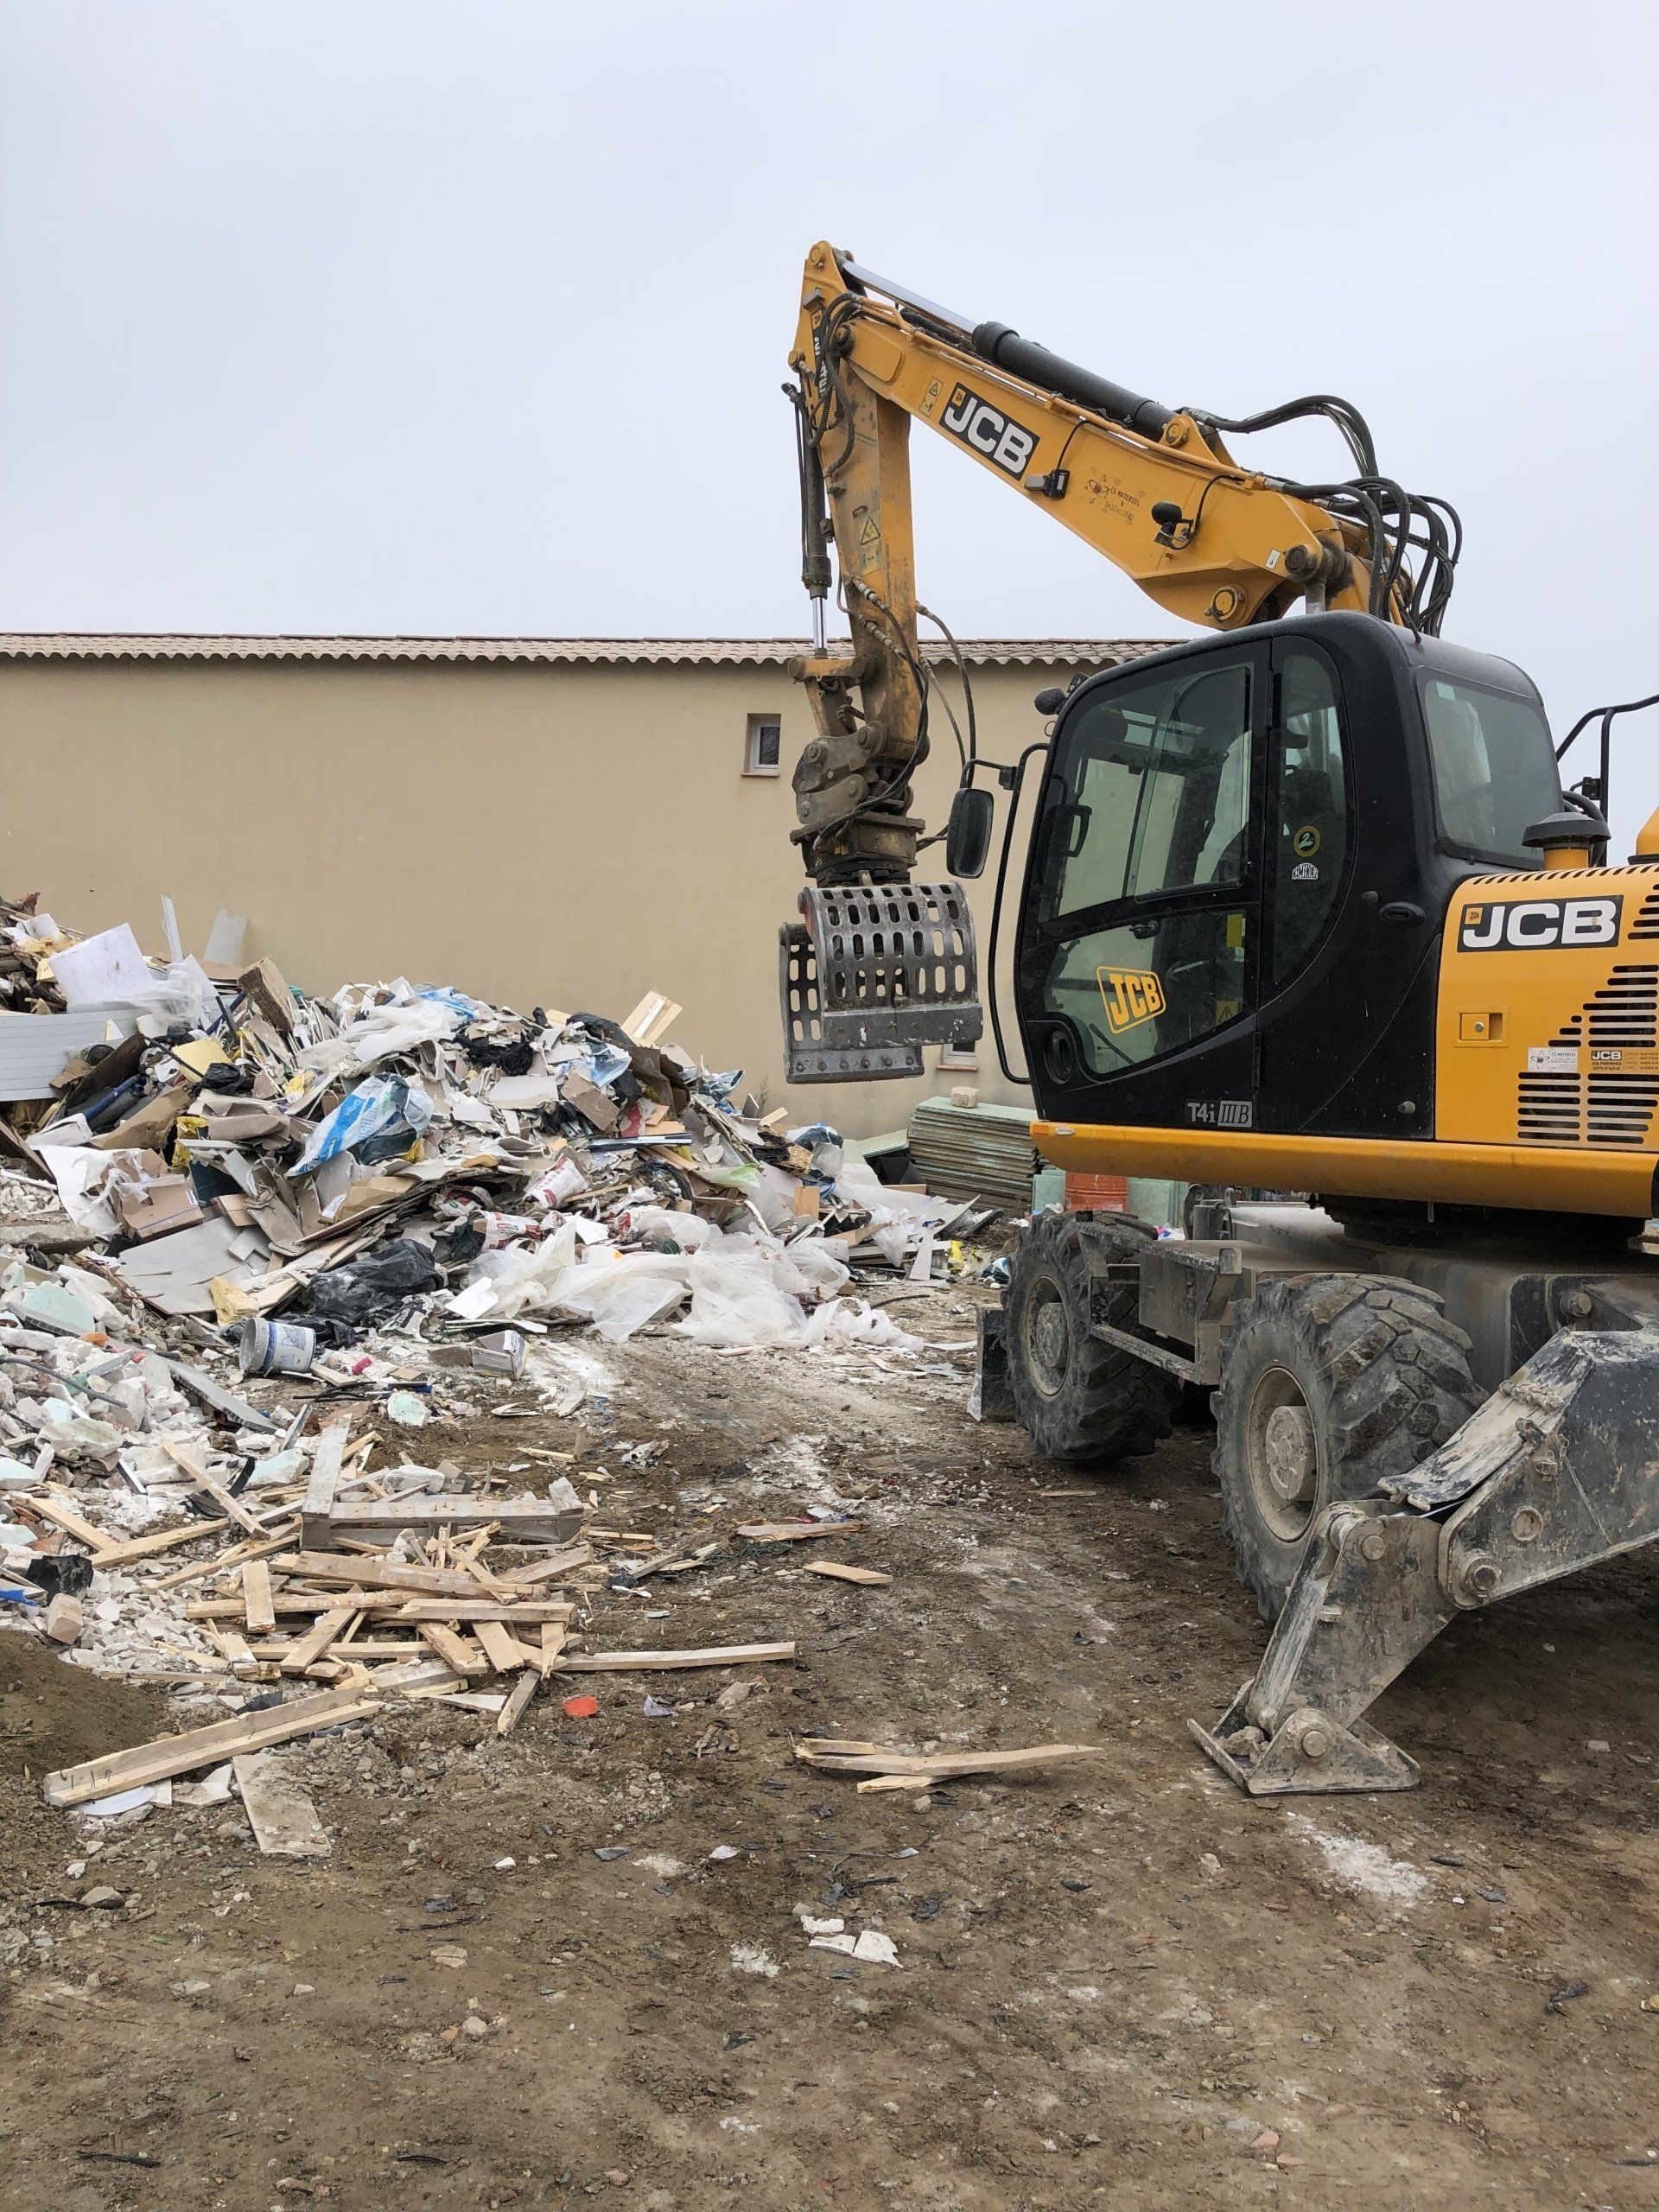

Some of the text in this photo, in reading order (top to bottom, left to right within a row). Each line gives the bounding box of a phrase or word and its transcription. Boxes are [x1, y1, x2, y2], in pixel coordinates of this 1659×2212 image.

[944, 397, 1033, 474] JCB
[1463, 900, 1617, 948] JCB
[1109, 973, 1161, 1026] JCB
[1592, 1051, 1622, 1060] JCB
[1187, 1103, 1217, 1123] T4i
